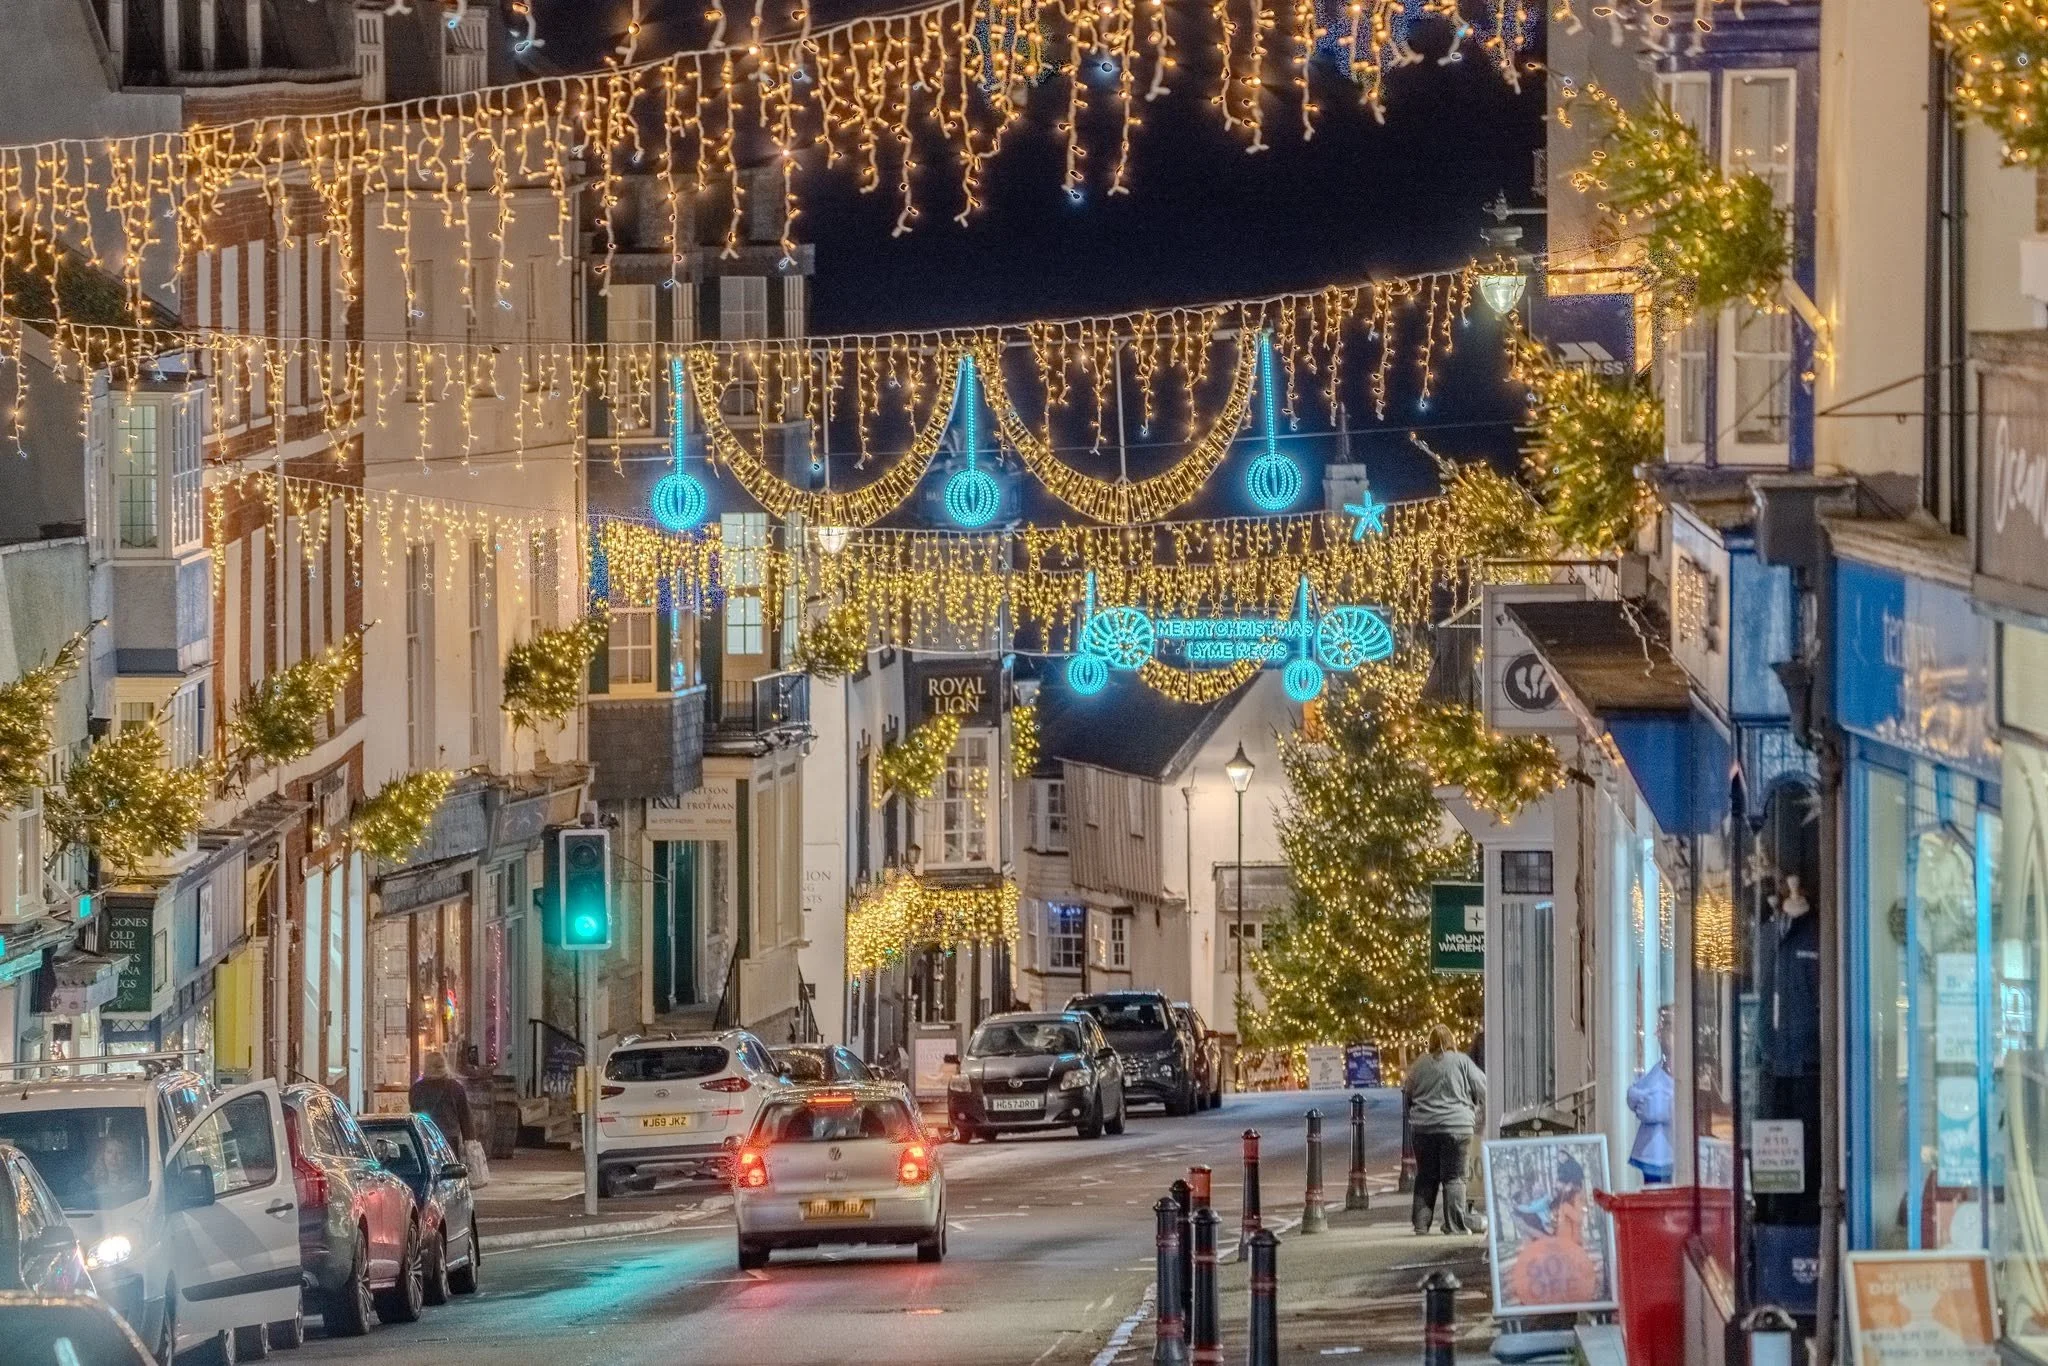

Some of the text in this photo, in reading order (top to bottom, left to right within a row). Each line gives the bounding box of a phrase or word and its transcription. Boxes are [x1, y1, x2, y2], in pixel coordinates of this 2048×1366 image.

[1157, 620, 1314, 637] MERRY CHRISTMAS
[1187, 641, 1287, 660] LYME REGIS
[928, 676, 987, 696] ROYAL
[935, 696, 980, 715] LION
[110, 929, 136, 940] OLD
[109, 940, 136, 950] PINE
[642, 1116, 687, 1127] WJ69 JKZ
